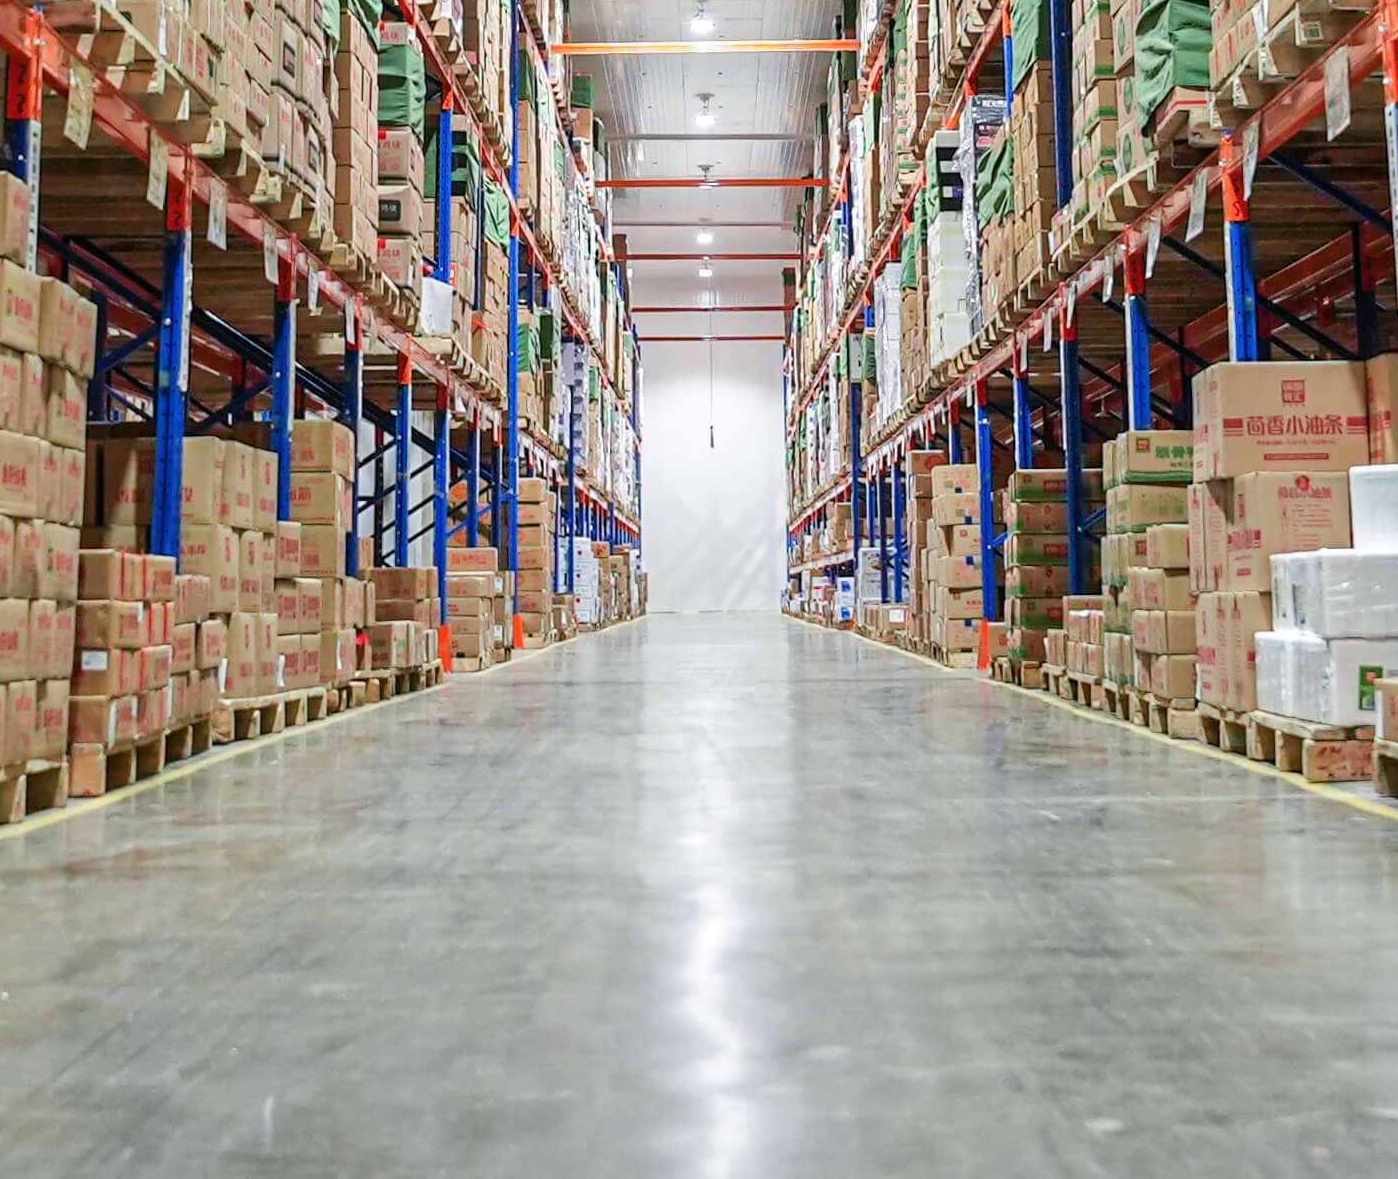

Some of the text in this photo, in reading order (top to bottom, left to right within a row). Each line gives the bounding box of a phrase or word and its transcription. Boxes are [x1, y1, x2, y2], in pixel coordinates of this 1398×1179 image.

[1246, 414, 1344, 437] 茴香小油条
